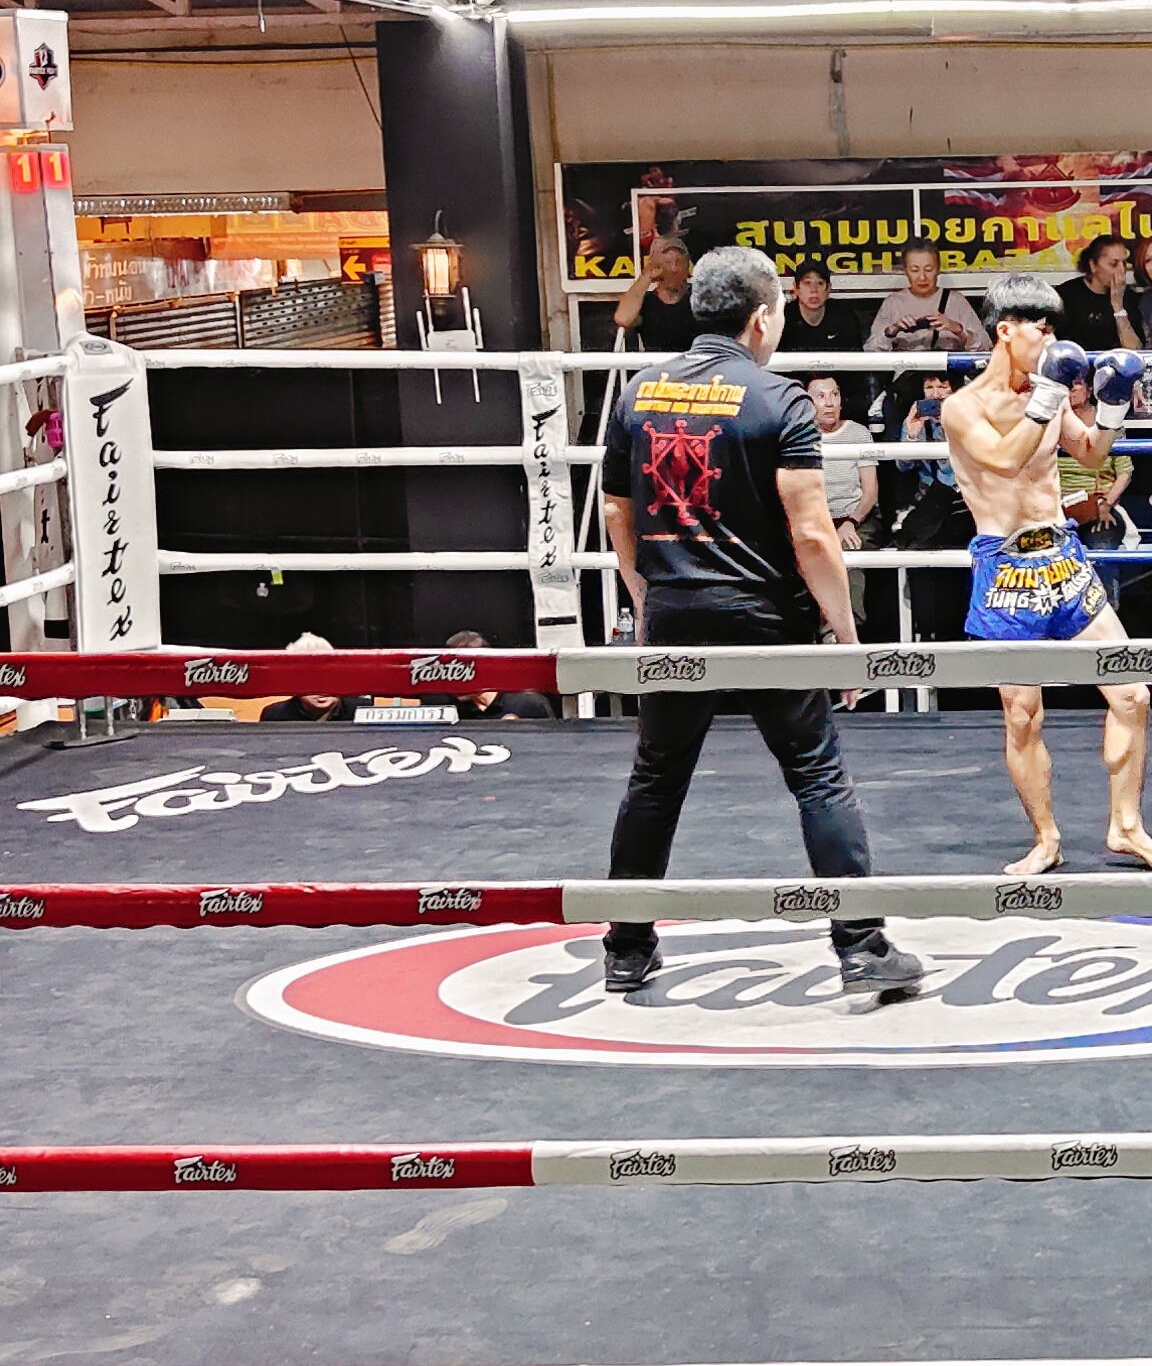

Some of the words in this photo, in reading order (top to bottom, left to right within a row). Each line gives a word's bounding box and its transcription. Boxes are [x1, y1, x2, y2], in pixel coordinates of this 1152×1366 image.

[531, 404, 562, 567] Fairtex
[90, 378, 134, 641] Fairtex
[184, 657, 248, 685] Fairtex
[409, 655, 475, 684] Fairtex
[637, 655, 706, 684] Fairtex
[866, 649, 935, 679] Fairtex
[16, 736, 512, 833] Fairtex
[199, 887, 264, 916] Fairtex
[417, 886, 483, 914] Fairtex
[773, 883, 841, 915] Fairtex
[996, 881, 1063, 912] Fairtex
[173, 1154, 237, 1184] Fairtex
[390, 1152, 455, 1181] Fairtex
[609, 1148, 676, 1179] Fairtex
[828, 1144, 897, 1175] Fairtex
[1051, 1140, 1118, 1168] Fairtex
